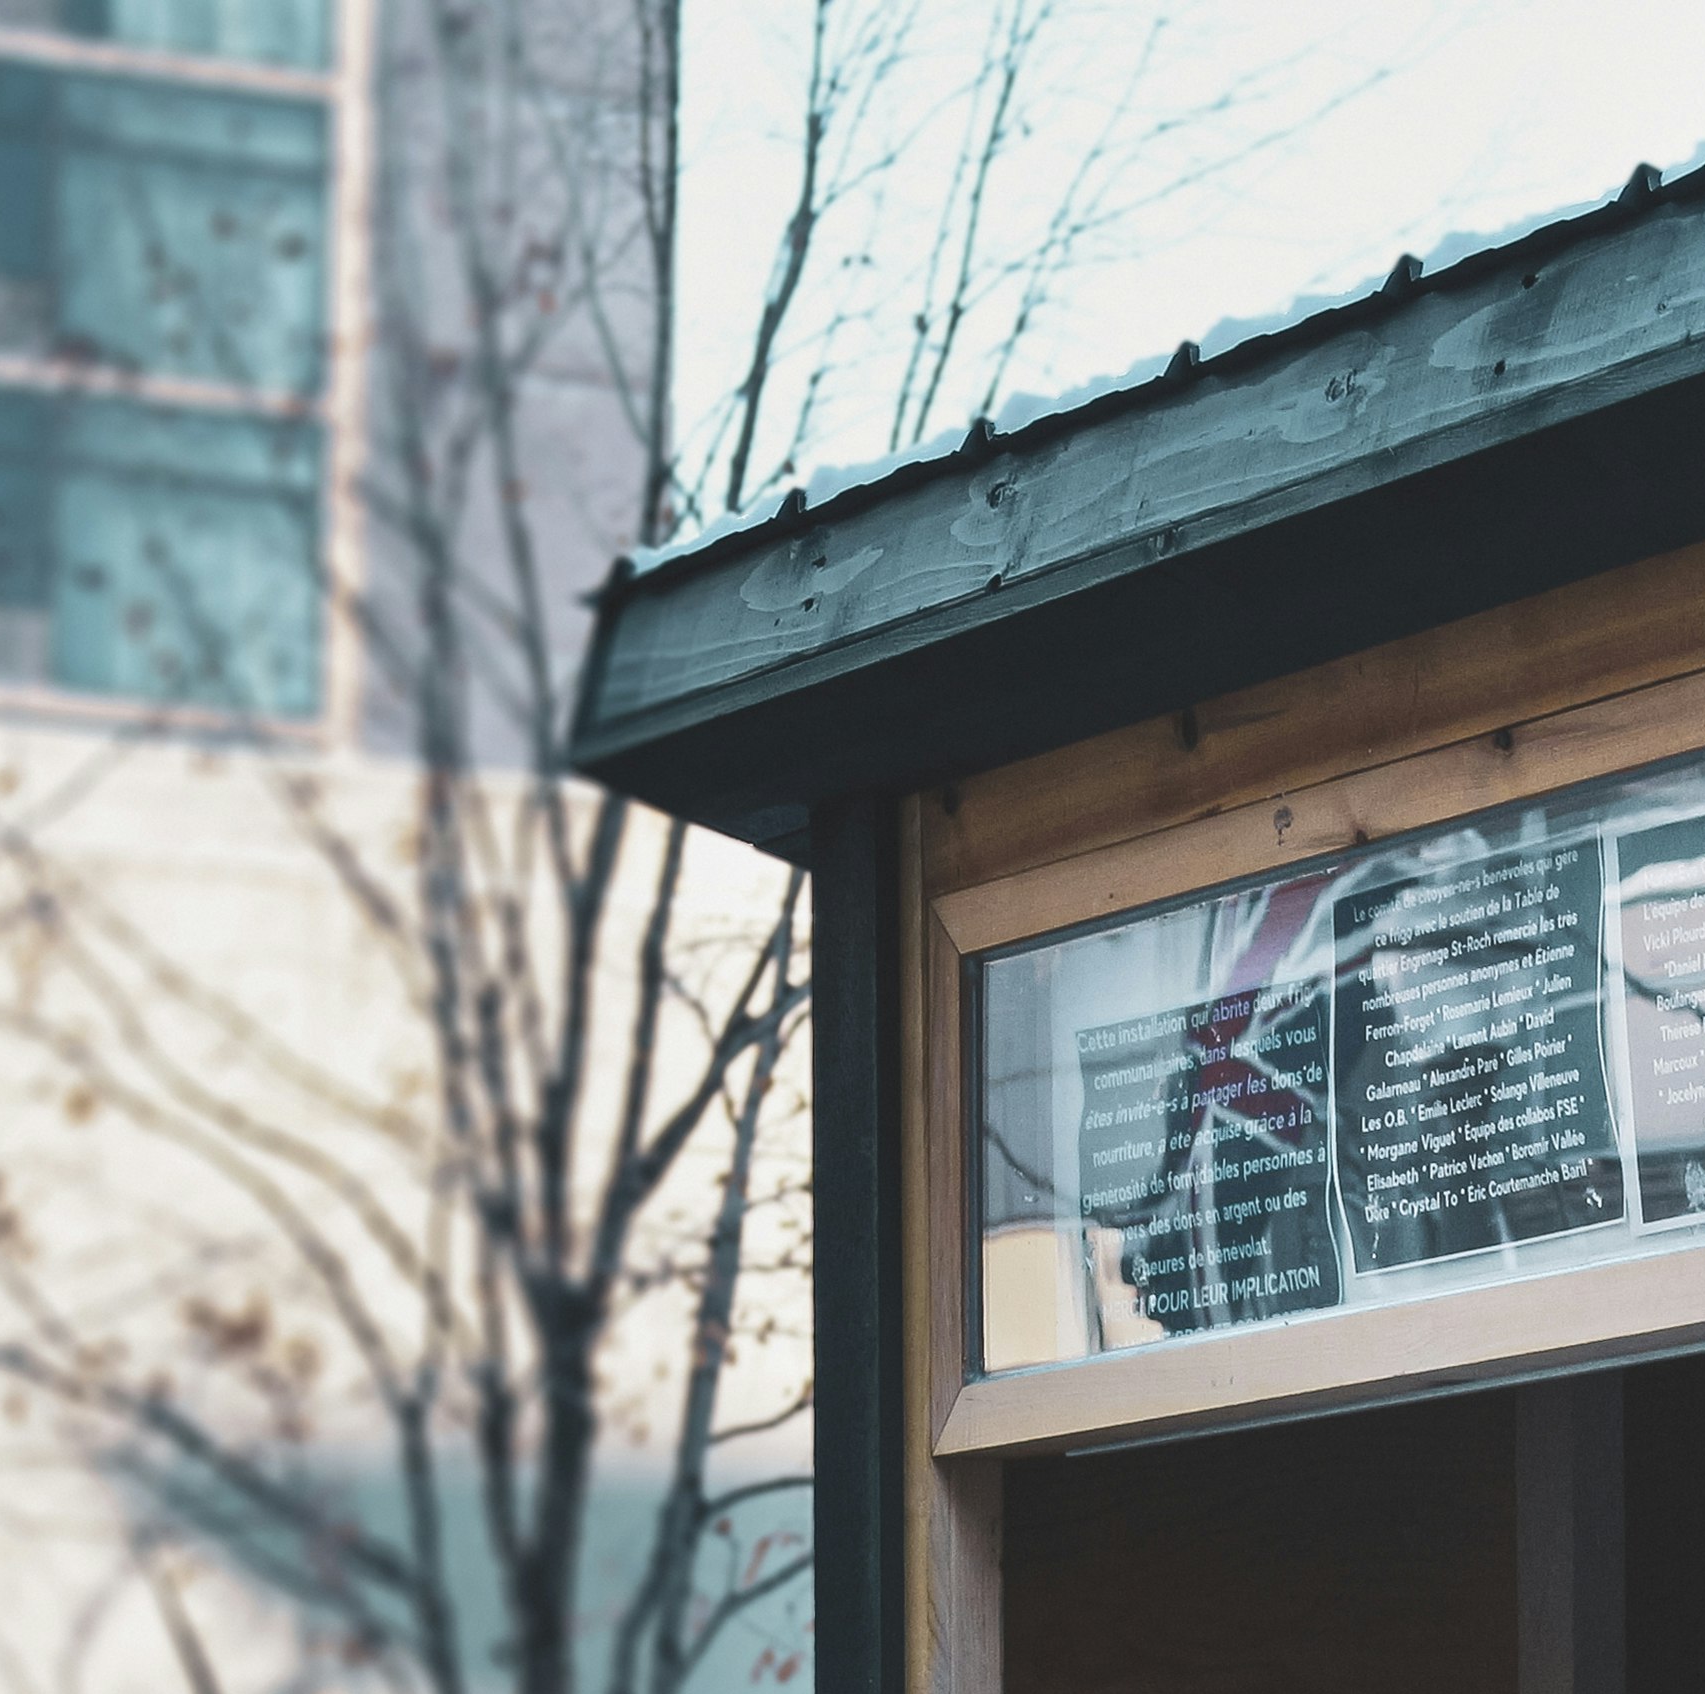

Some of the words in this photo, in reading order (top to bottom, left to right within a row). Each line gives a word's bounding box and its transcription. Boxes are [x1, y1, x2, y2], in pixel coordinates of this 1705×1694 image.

[1449, 904, 1484, 927] soutien
[1486, 900, 1500, 916] de
[1503, 894, 1512, 912] la
[1514, 887, 1543, 909] Table
[1546, 884, 1560, 900] de
[1644, 900, 1688, 923] L'équipe
[1401, 948, 1448, 975] Engrenage
[1451, 933, 1491, 957] St-Roch
[1493, 922, 1537, 943] remercie
[1540, 914, 1555, 934] les
[1557, 910, 1578, 929] très
[1644, 931, 1670, 952] Vicki
[1362, 984, 1420, 1012] nombreuses
[1421, 973, 1469, 1002] personnes
[1471, 959, 1520, 985] anonymes
[1522, 953, 1533, 968] et
[1535, 942, 1575, 964] Étienne
[1077, 1030, 1116, 1053] Cette
[1119, 1014, 1186, 1045] installation
[1192, 1000, 1209, 1033] qui
[1212, 998, 1250, 1023] abrite
[1253, 988, 1282, 1013] deux
[1365, 1006, 1435, 1042] Ferron-Forget
[1443, 998, 1490, 1021] Rosemarie
[1493, 984, 1533, 1008] Lemieux
[1542, 974, 1572, 995] Julien
[1385, 1040, 1445, 1068] Chapdelaine
[1452, 1026, 1488, 1049] Laurent
[1490, 1017, 1517, 1040] Aubin
[1526, 1007, 1555, 1029] David
[1660, 1022, 1701, 1043] Thérèse
[1200, 1043, 1226, 1066] dans
[1230, 1027, 1282, 1061] lesquels
[1285, 1024, 1316, 1047] vous
[1366, 1077, 1421, 1101] Galarneau
[1430, 1061, 1476, 1087] Alexandre
[1477, 1055, 1499, 1074] Paré
[1506, 1045, 1533, 1067] Gilles
[1534, 1038, 1566, 1060] Poirier
[1653, 1055, 1698, 1076] Marcoux
[1086, 1106, 1113, 1130] êtes
[1115, 1094, 1178, 1125] invité-e-s
[1181, 1089, 1189, 1110] à
[1192, 1079, 1243, 1114] partager
[1247, 1073, 1267, 1095] les
[1271, 1067, 1302, 1091] dons
[1307, 1061, 1322, 1082] de
[1170, 1130, 1191, 1150] été
[1195, 1119, 1241, 1146] acquise
[1244, 1109, 1284, 1136] grâce
[1288, 1106, 1296, 1125] à
[1300, 1102, 1312, 1125] la
[1361, 1115, 1381, 1132] Les
[1384, 1110, 1409, 1127] O.B.
[1450, 1091, 1483, 1113] Leclerc
[1490, 1080, 1528, 1104] Solange
[1529, 1068, 1580, 1092] Villeneuve
[1367, 1165, 1419, 1192] Elisabeth
[1430, 1157, 1468, 1179] Patrice
[1470, 1149, 1505, 1171] Vachon
[1512, 1137, 1549, 1161] Boromir
[1551, 1129, 1585, 1151] Vallée
[1368, 1138, 1418, 1165] Morgane
[1421, 1128, 1456, 1150] Viguet
[1464, 1119, 1496, 1142] Équipe
[1498, 1115, 1514, 1132] des
[1516, 1103, 1555, 1127] collabos
[1557, 1096, 1578, 1117] FSE
[1083, 1178, 1148, 1215] générosité
[1150, 1173, 1165, 1194] de
[1244, 1148, 1313, 1182] personnes
[1148, 1214, 1170, 1236] des
[1174, 1205, 1203, 1230] dons
[1206, 1207, 1221, 1224] en
[1223, 1197, 1262, 1225] argent
[1265, 1194, 1281, 1211] ou
[1284, 1187, 1307, 1210] des
[1400, 1192, 1440, 1219] Crystal
[1444, 1190, 1458, 1207] To
[1468, 1179, 1487, 1202] Éric
[1489, 1166, 1559, 1197] Courtemanche
[1562, 1158, 1587, 1180] Baril
[1189, 1248, 1204, 1268] de
[1207, 1236, 1272, 1266] bénévolat.
[1148, 1291, 1189, 1315] POUR
[1193, 1282, 1229, 1308] LEUR
[1231, 1265, 1320, 1300] IMPLICATION
